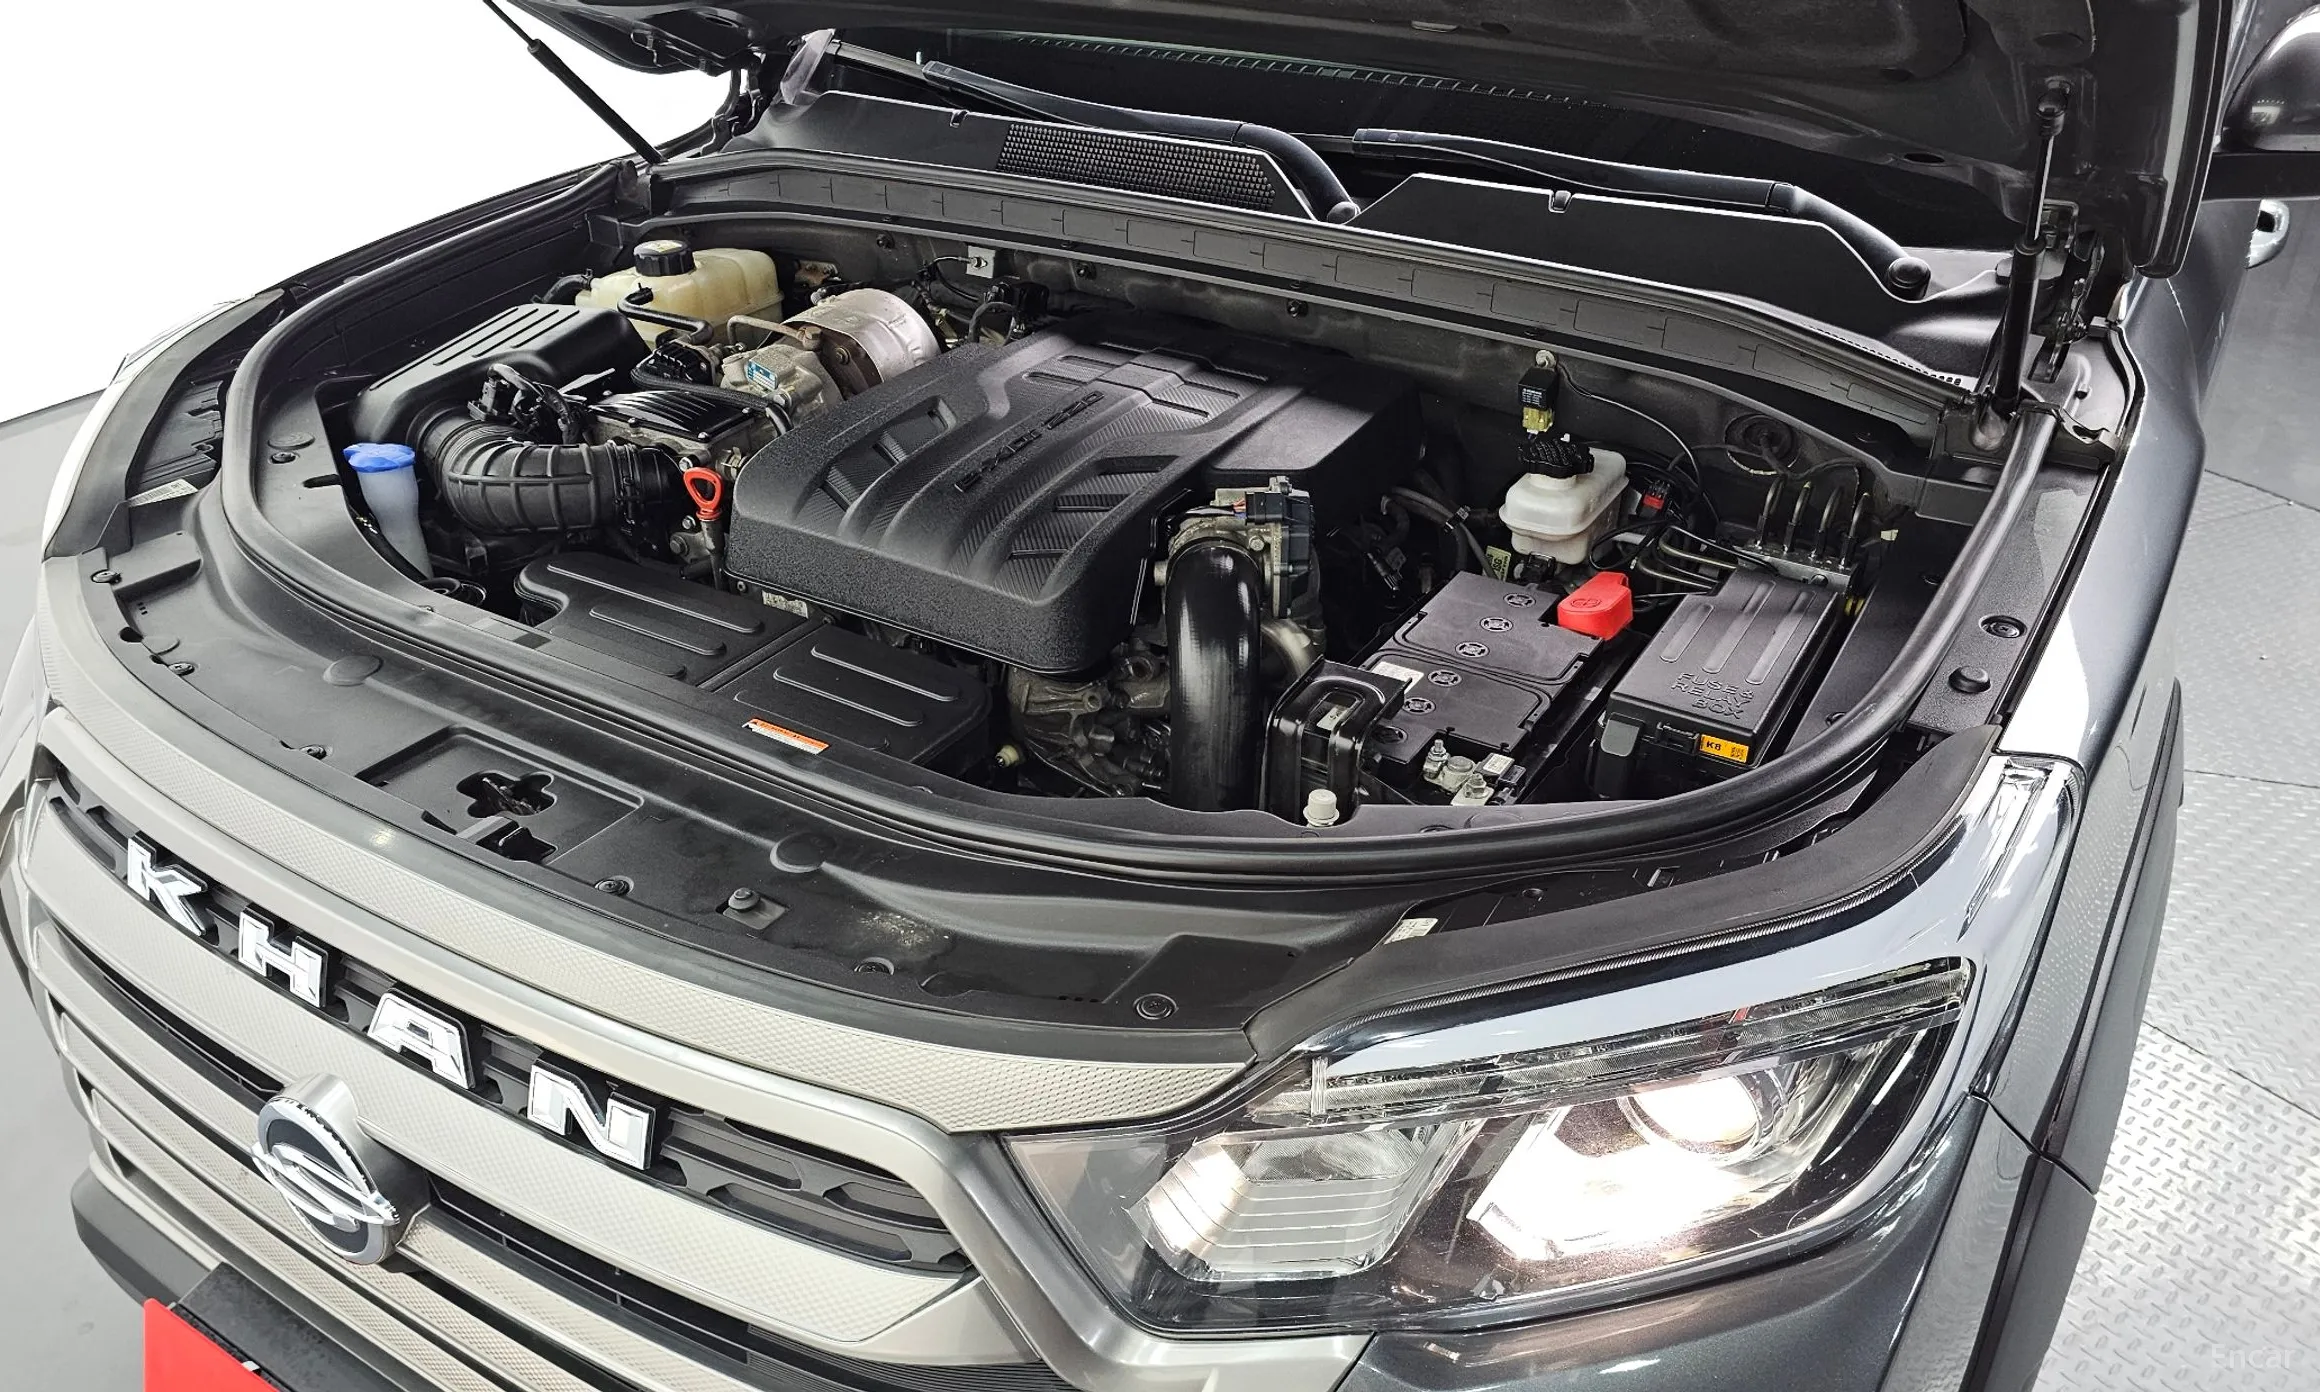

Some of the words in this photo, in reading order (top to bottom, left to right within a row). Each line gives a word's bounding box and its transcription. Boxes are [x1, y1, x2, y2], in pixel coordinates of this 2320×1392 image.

[1671, 682, 1751, 708] RELAY
[1678, 672, 1739, 695] FUSE
[1692, 699, 1744, 719] BOX
[1706, 740, 1722, 751] K8
[128, 832, 656, 1170] KHAN
